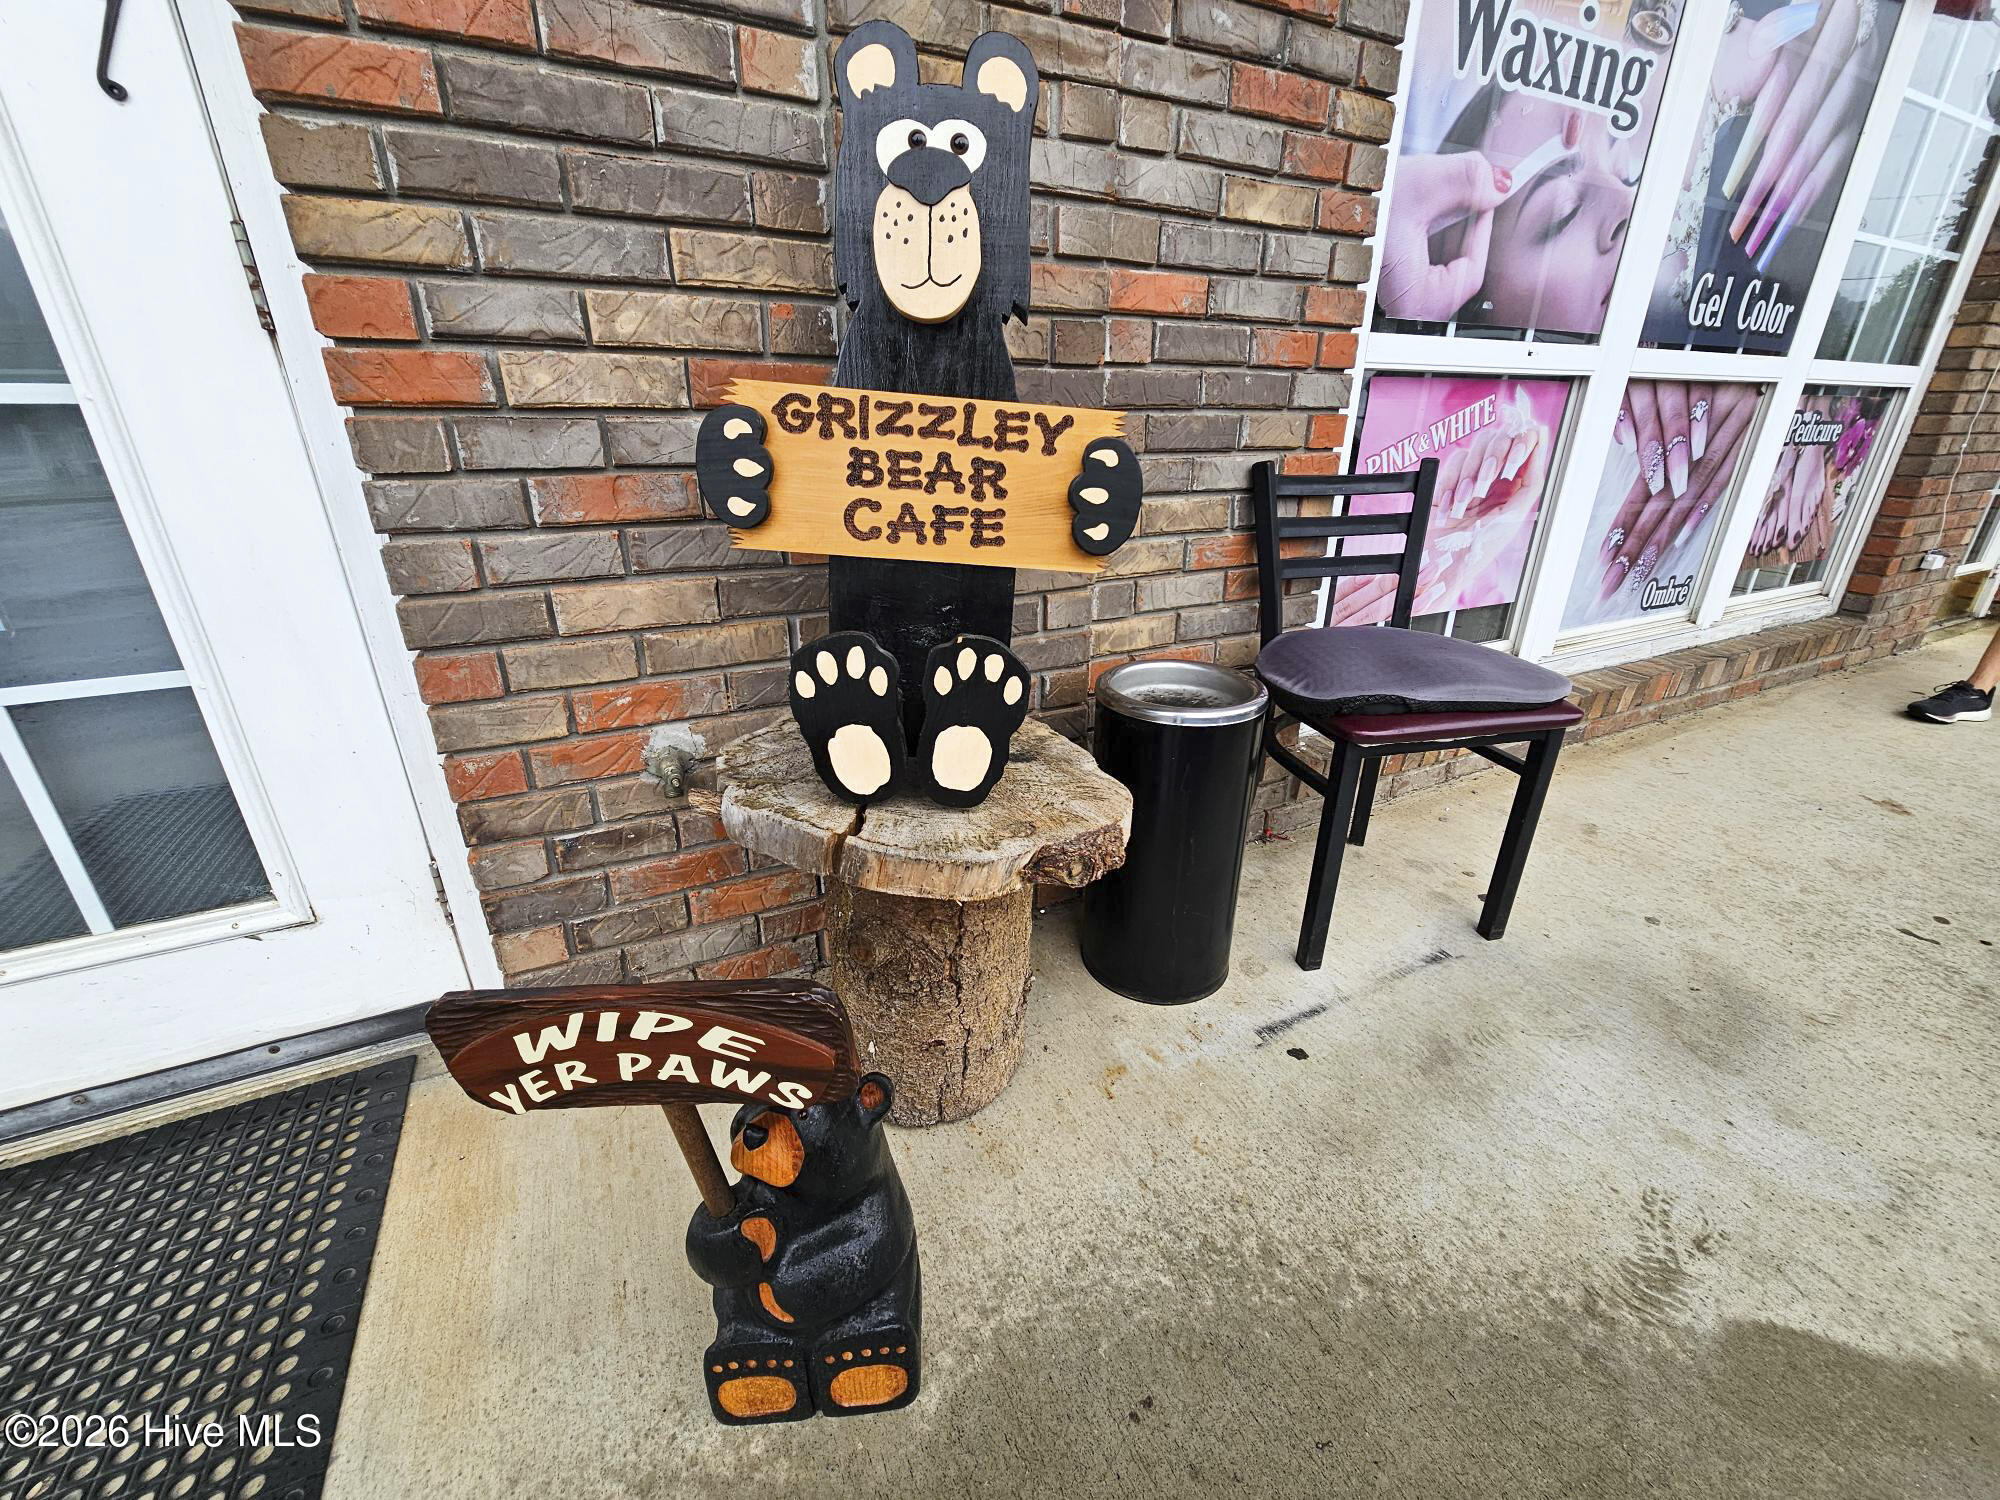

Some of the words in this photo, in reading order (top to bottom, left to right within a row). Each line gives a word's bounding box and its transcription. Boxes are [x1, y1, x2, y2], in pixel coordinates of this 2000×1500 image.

[1457, 0, 1655, 132] Waxing
[1688, 272, 1735, 328] Gel
[1737, 278, 1795, 335] Color
[770, 391, 1075, 456] GRIZZLEY
[1429, 392, 1497, 453] WHITE
[1783, 411, 1843, 444] Pedicure
[845, 446, 1008, 502] BEAR
[843, 496, 1006, 549] CAFE
[1642, 577, 1692, 609] Ombré
[512, 1010, 767, 1065] WIPE
[488, 1059, 598, 1116] YER
[615, 1052, 813, 1110] PAWS
